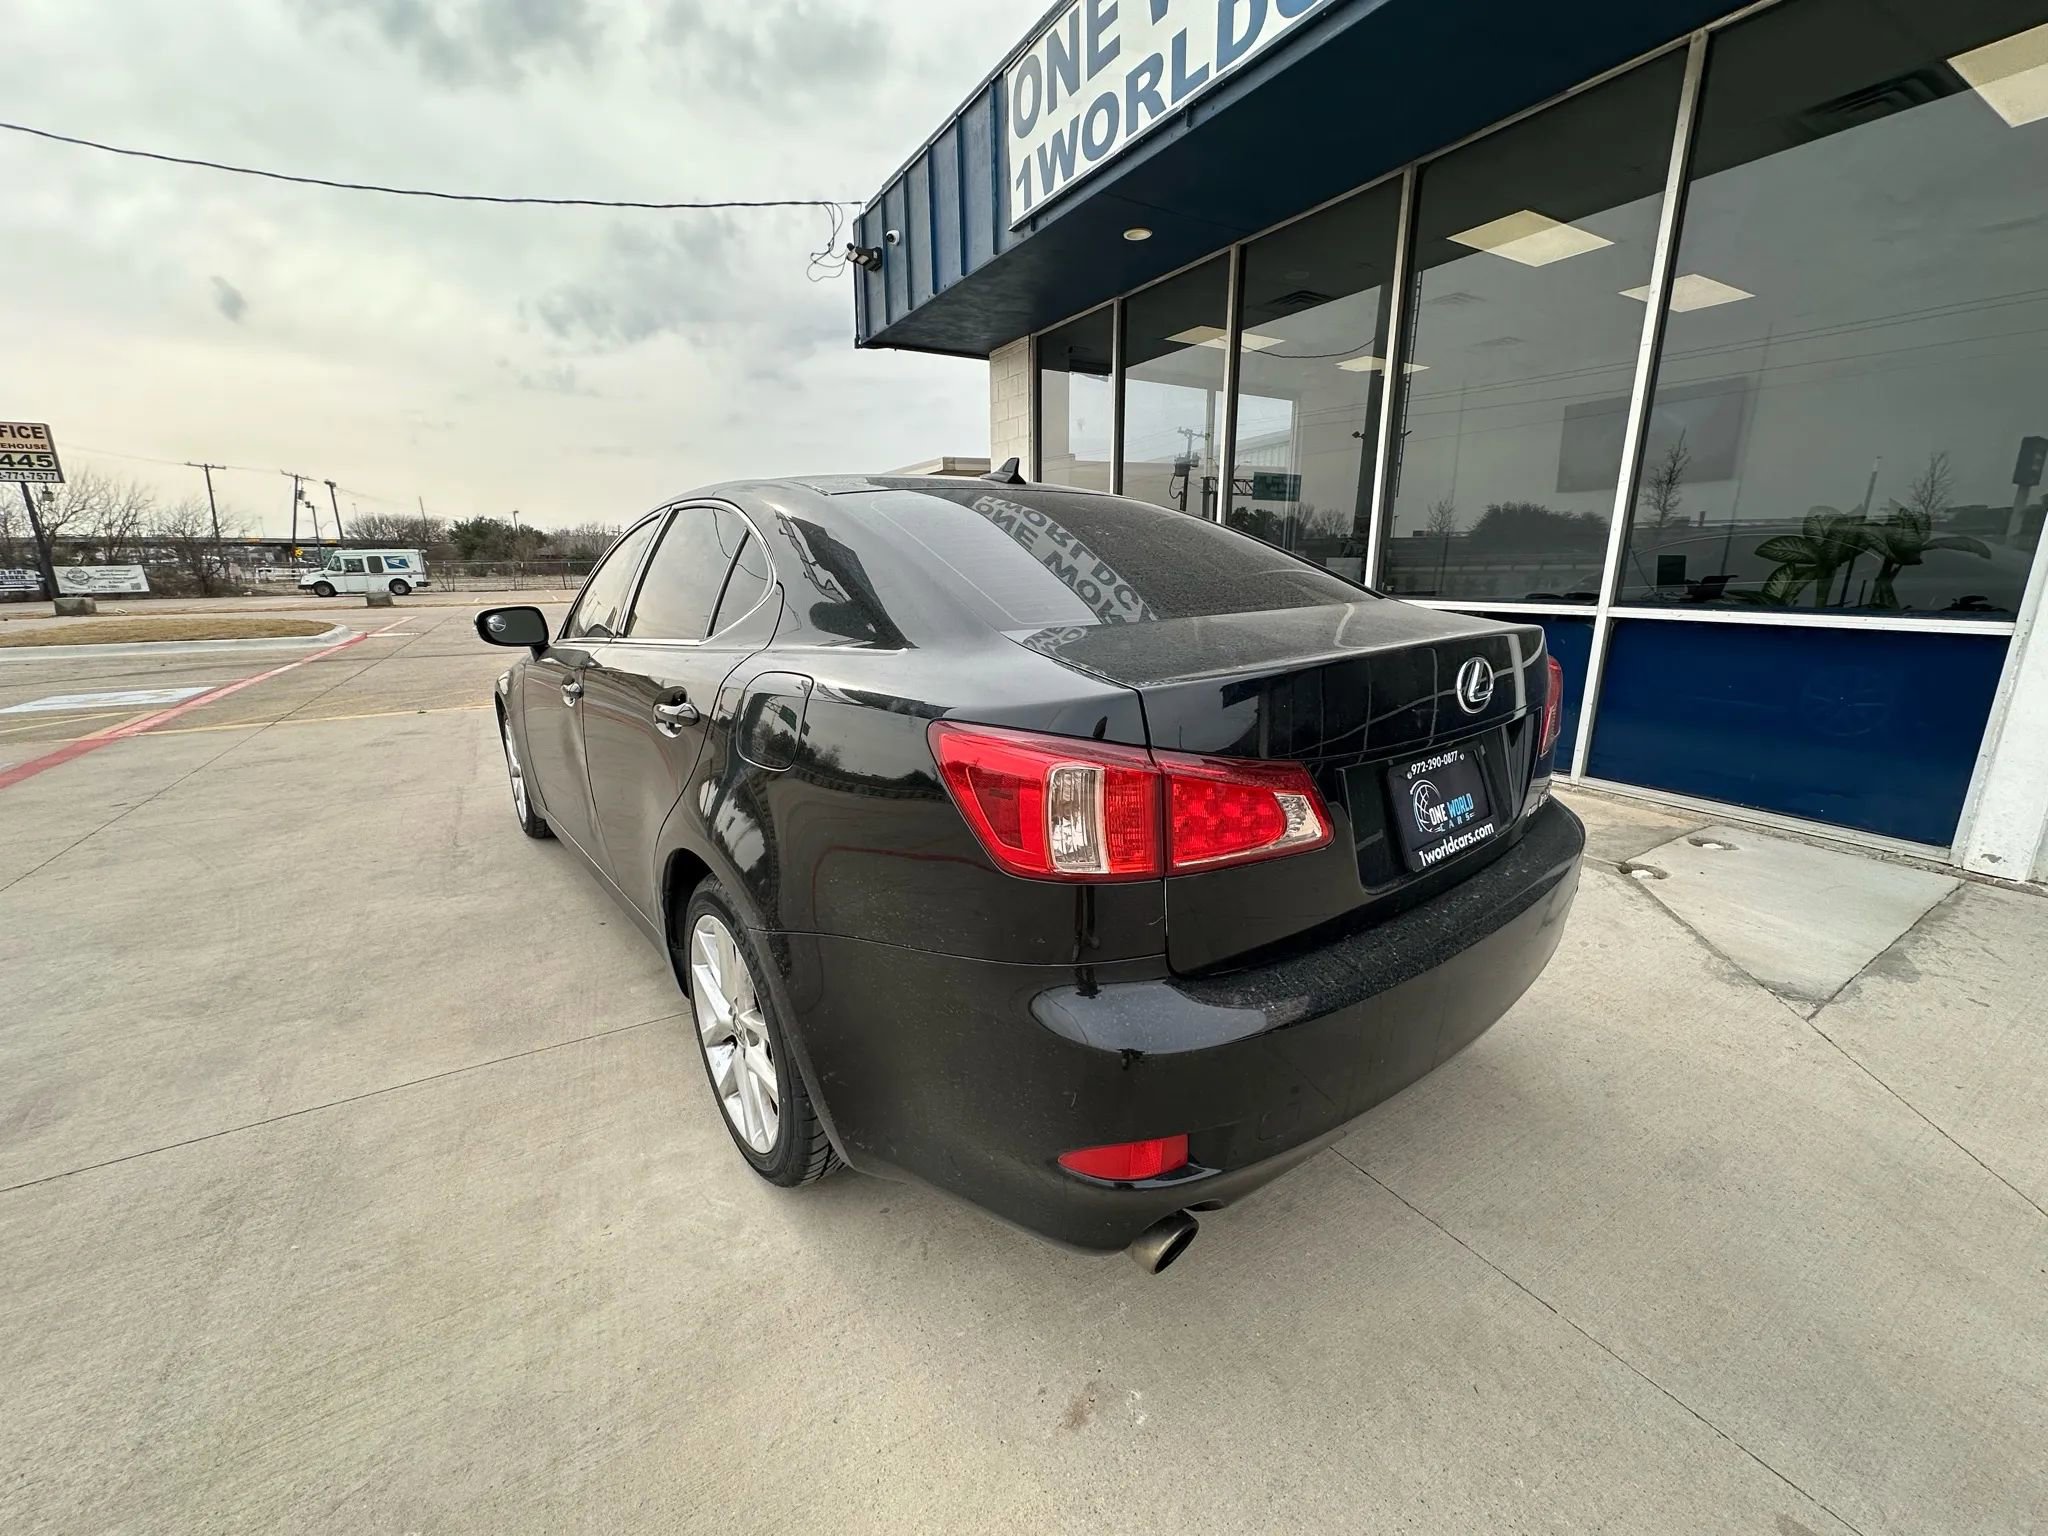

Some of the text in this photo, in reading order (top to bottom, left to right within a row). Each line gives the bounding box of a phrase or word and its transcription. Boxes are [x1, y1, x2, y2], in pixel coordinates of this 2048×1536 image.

[1013, 0, 1121, 139] ONE
[0, 424, 44, 439] FICE
[0, 471, 56, 481] -771-7577
[1410, 750, 1459, 776] 972-290-0877
[1429, 793, 1474, 826] ONE WORLD
[1439, 812, 1471, 833] CARS
[1418, 822, 1495, 867] 1worldcars.com
